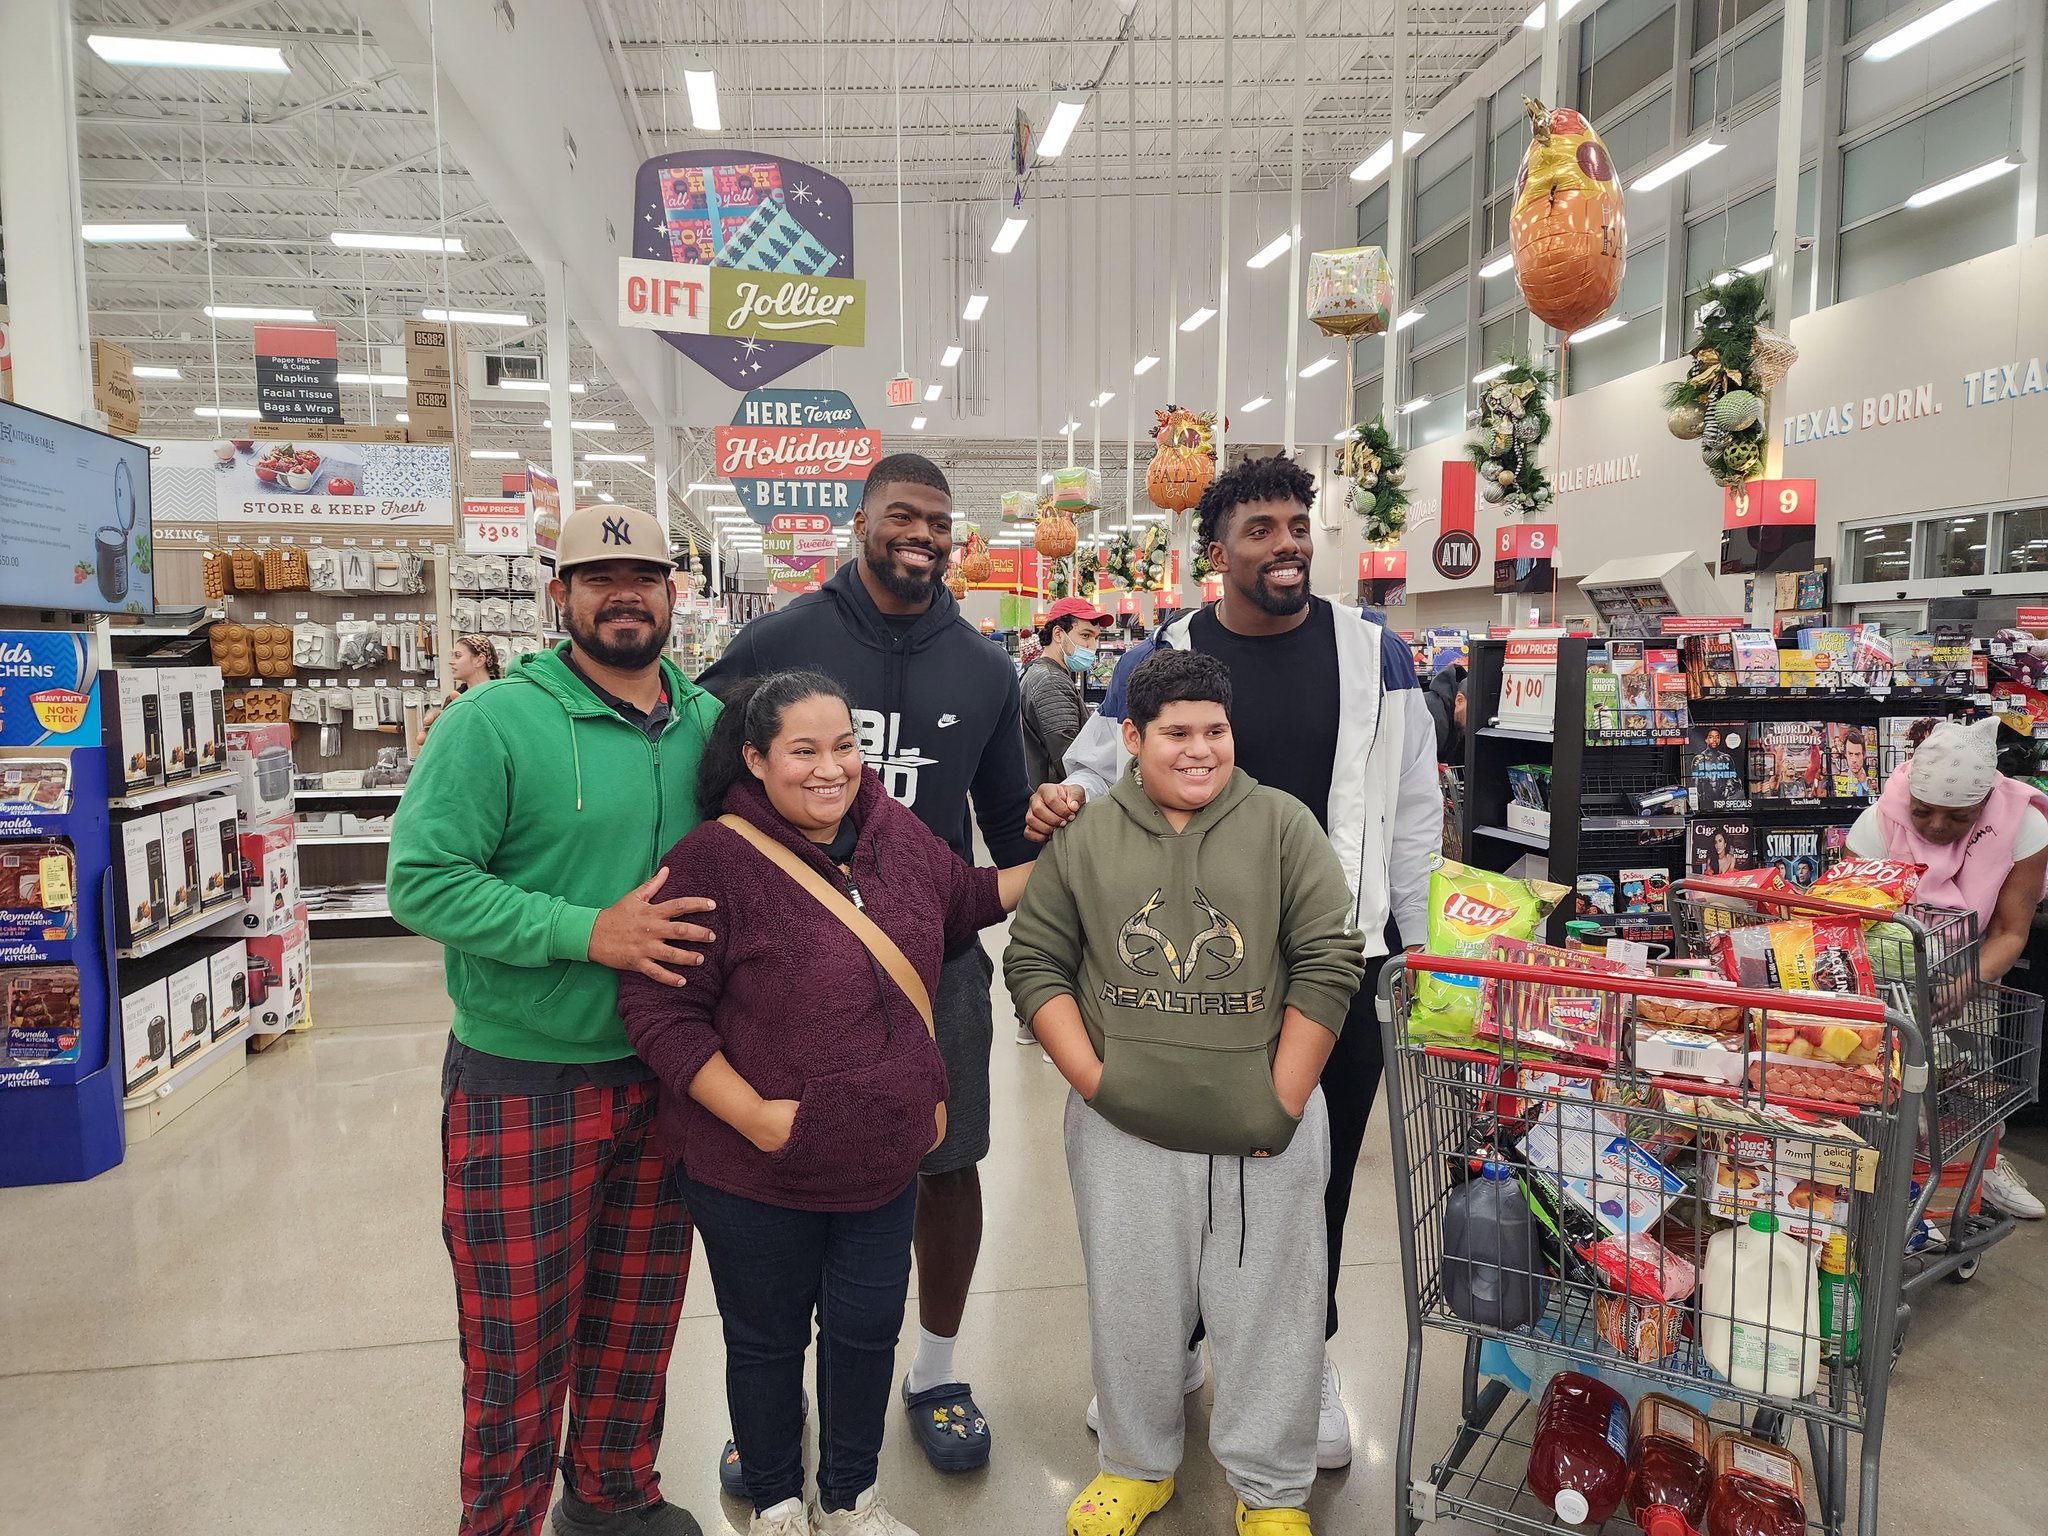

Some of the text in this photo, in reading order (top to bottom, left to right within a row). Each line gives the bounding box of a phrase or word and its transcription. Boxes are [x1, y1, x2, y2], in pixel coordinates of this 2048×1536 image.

[627, 276, 855, 330] GIFT Jollier
[416, 332, 444, 347] 85882
[271, 357, 320, 366] Paper Plates
[275, 373, 319, 384] Napkins
[1963, 357, 2048, 408] TEXA
[263, 389, 333, 399] Facial Tissue
[891, 381, 914, 404] EXIT
[418, 393, 447, 408] 85882
[264, 403, 334, 415] Bags & Wrap
[746, 401, 852, 426] HERE Texas
[1783, 382, 1943, 447] TEXAS BORN.
[282, 416, 323, 424] Household
[12, 429, 35, 445] KITCHEN
[39, 437, 55, 451] TABLE
[723, 433, 872, 473] Holidays
[794, 464, 821, 475] are
[1152, 468, 1198, 485] FALL
[1549, 453, 1641, 496] HOLE FAMILY.
[756, 481, 849, 507] BETTER
[1779, 489, 1799, 513] 9
[244, 500, 427, 517] STORE & KEEP Fresh
[467, 505, 520, 513] LOW PRICES
[763, 538, 837, 550] ENJOY Sweeter
[1501, 533, 1510, 551] 8
[1530, 531, 1545, 550] 8
[1441, 542, 1474, 567] ATM
[1384, 556, 1397, 571] 7
[1165, 594, 1174, 604] 4
[1510, 643, 1557, 655] LOW PRICES
[1592, 684, 1616, 692] KNOTS
[47, 706, 79, 714] NON-
[44, 715, 77, 723] STICK
[941, 713, 957, 723] NIKE
[1600, 729, 1681, 738] REFERENCE GUIDES
[1773, 725, 1810, 734] WORLD
[1764, 734, 1822, 745] CHAMPIONS
[1726, 799, 1752, 808] SPECIALS
[1723, 824, 1749, 834] Snob
[1767, 834, 1818, 857] STAR TREK
[0, 911, 44, 924] Reynolds
[248, 916, 255, 924] 7
[5, 954, 48, 962] KITCHENS
[1526, 943, 1533, 951] 5
[1533, 945, 1559, 957] FLAVORS
[1567, 952, 1573, 960] 1
[1573, 953, 1590, 964] CANE
[1099, 980, 1266, 1015] REALTREE
[1552, 1006, 1597, 1021] Skittles
[11, 1028, 49, 1040] Reynolds
[8, 1078, 51, 1087] KITCHENS
[1731, 1135, 1773, 1151] Snack
[1620, 1143, 1649, 1167] Hstess
[1846, 1164, 1864, 1172] MLK
[1630, 1314, 1639, 1360] Maruchan
